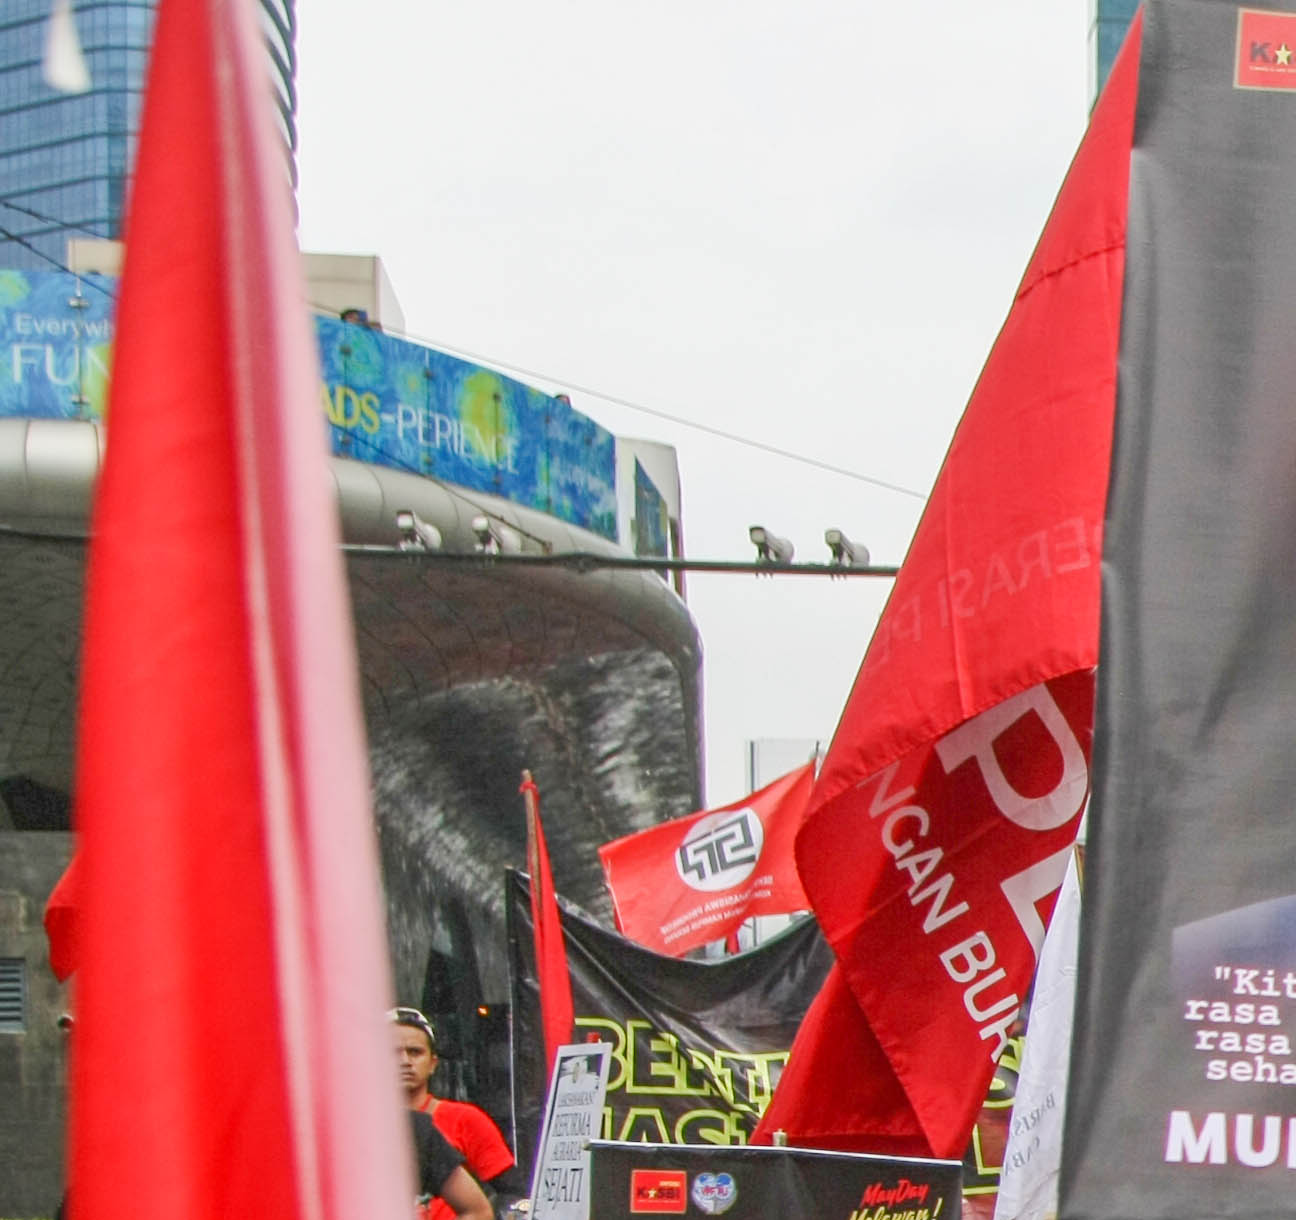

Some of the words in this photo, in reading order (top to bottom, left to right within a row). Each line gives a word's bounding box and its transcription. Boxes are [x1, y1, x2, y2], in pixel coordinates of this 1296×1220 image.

[1184, 999, 1281, 1027] rasa
[1195, 1029, 1292, 1056] rasa
[861, 1178, 929, 1208] MayDay
